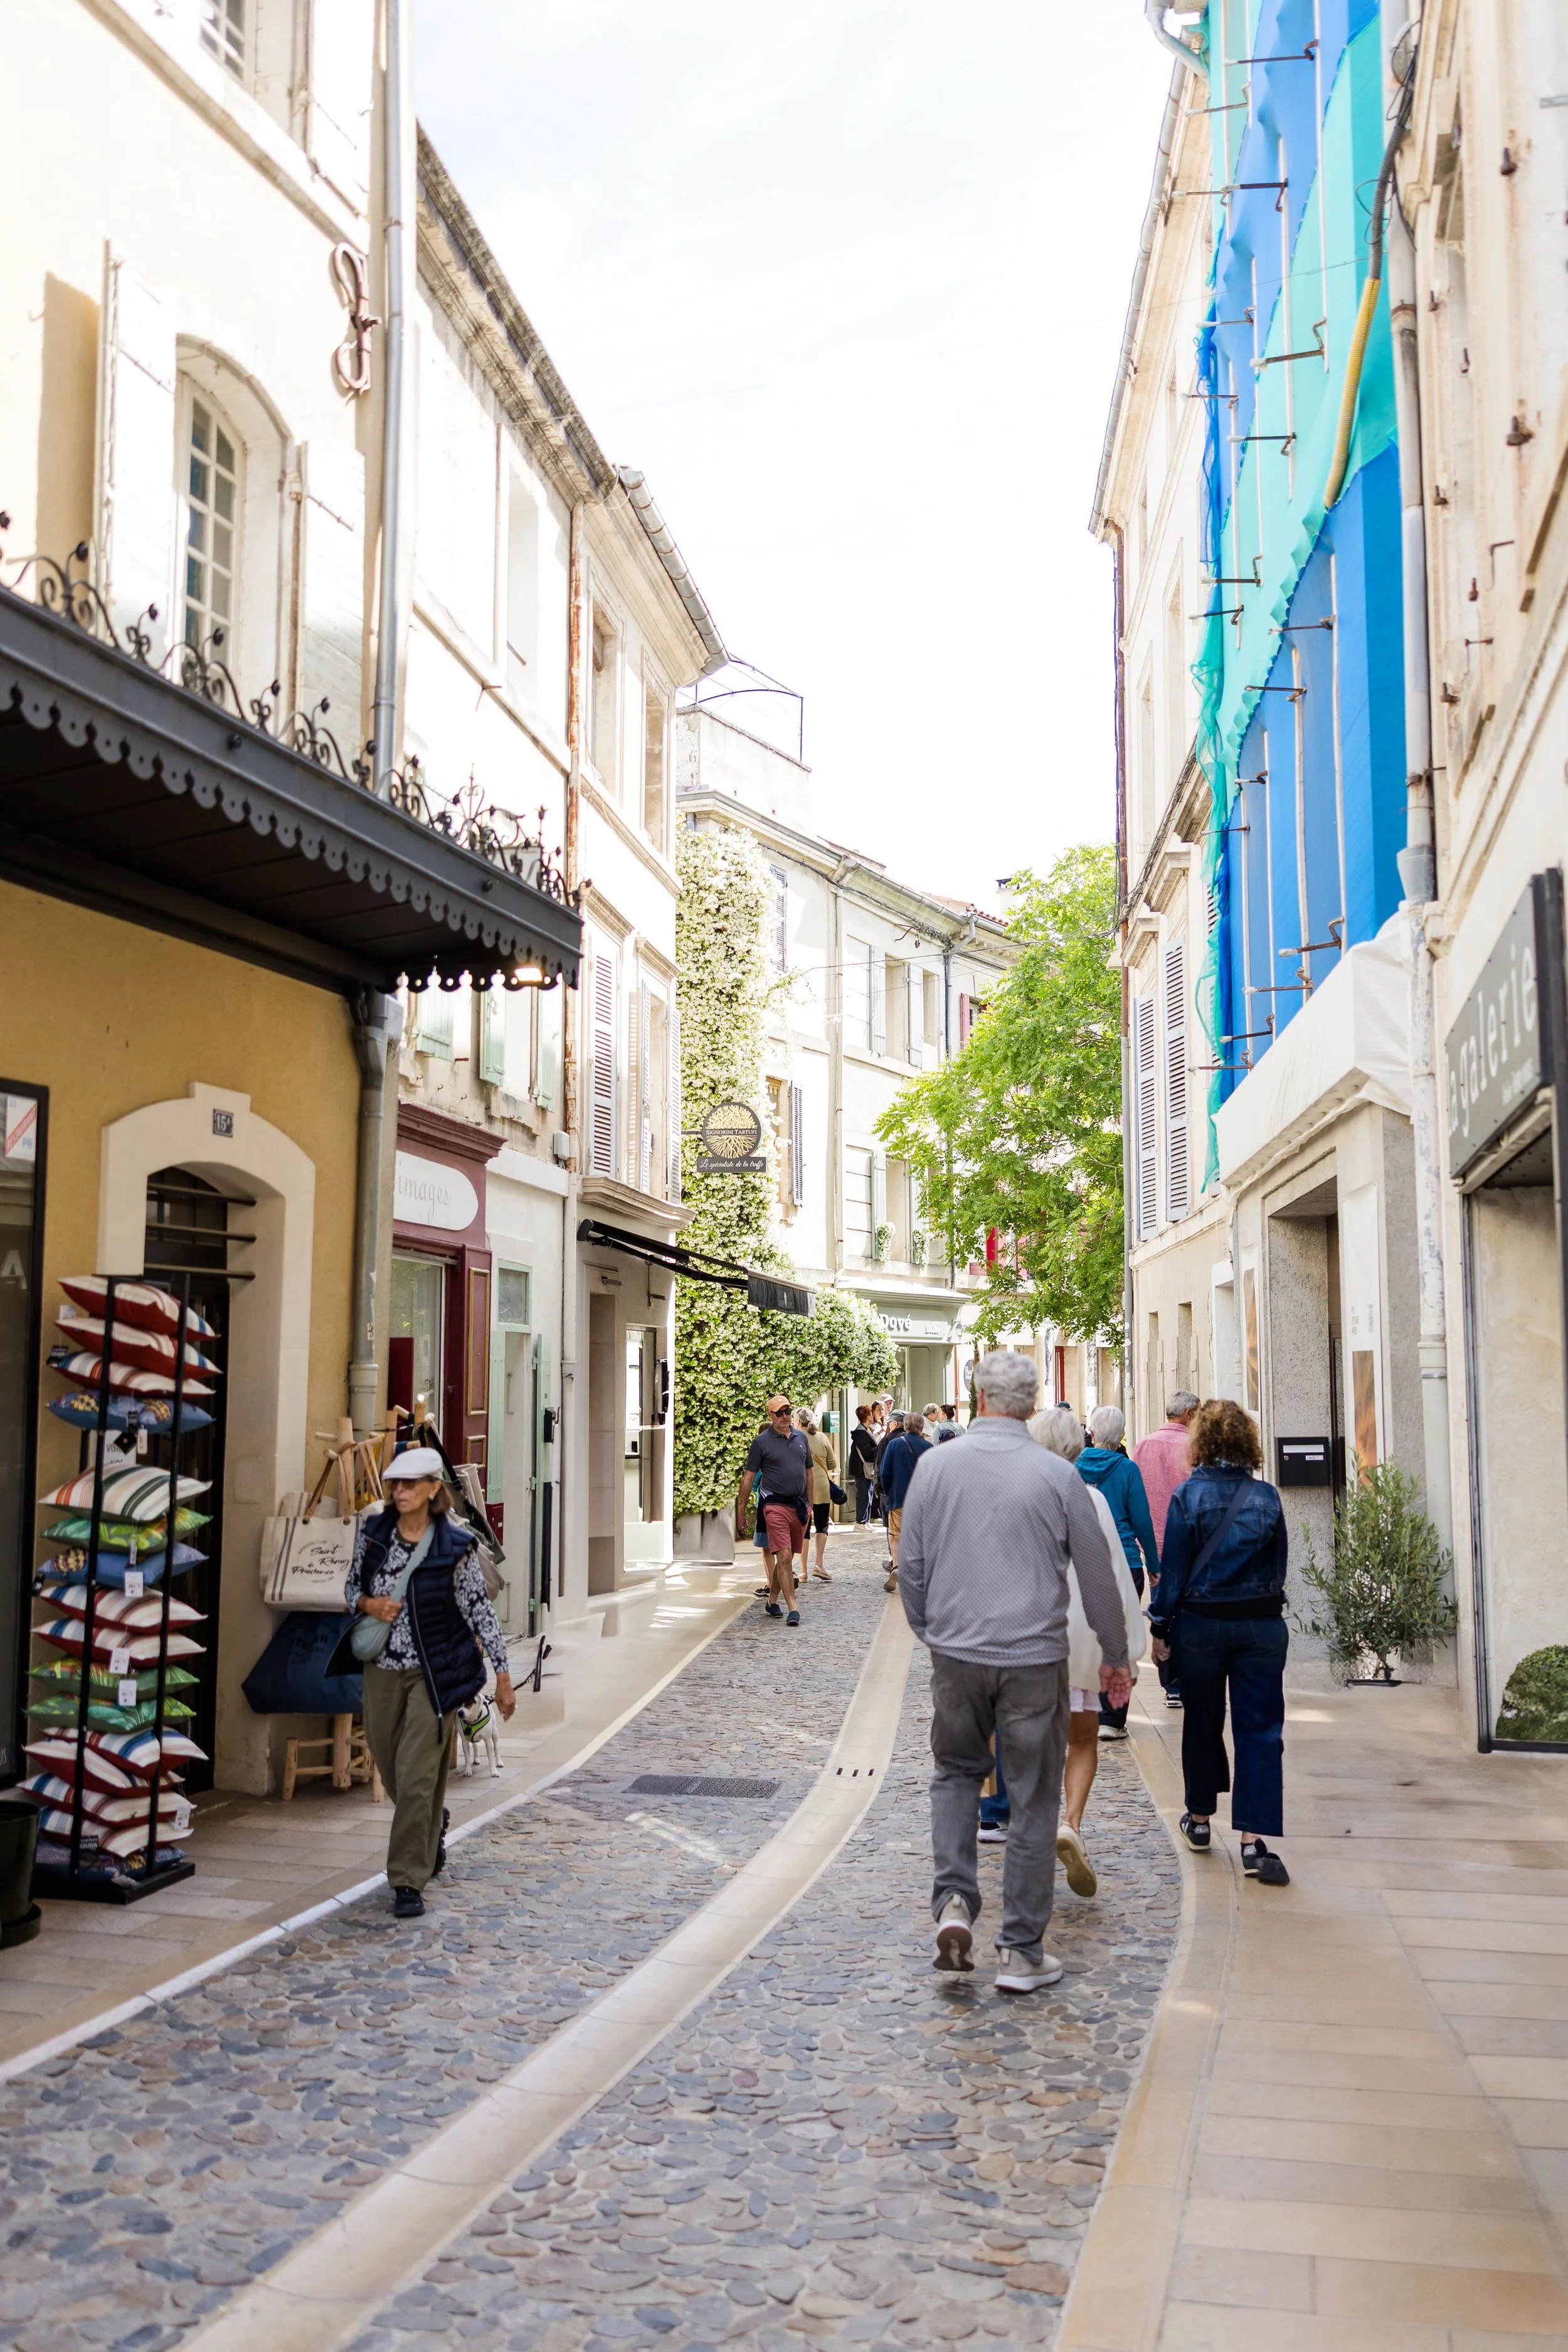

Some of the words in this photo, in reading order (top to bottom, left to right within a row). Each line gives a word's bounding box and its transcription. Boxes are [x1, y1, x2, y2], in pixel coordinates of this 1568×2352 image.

[1459, 943, 1536, 1138] galerie
[699, 1159, 709, 1169] Le
[710, 1161, 734, 1169] spécialiste
[750, 1160, 764, 1170] truffe
[310, 1544, 343, 1555] Saint
[292, 1566, 334, 1574] Provence
